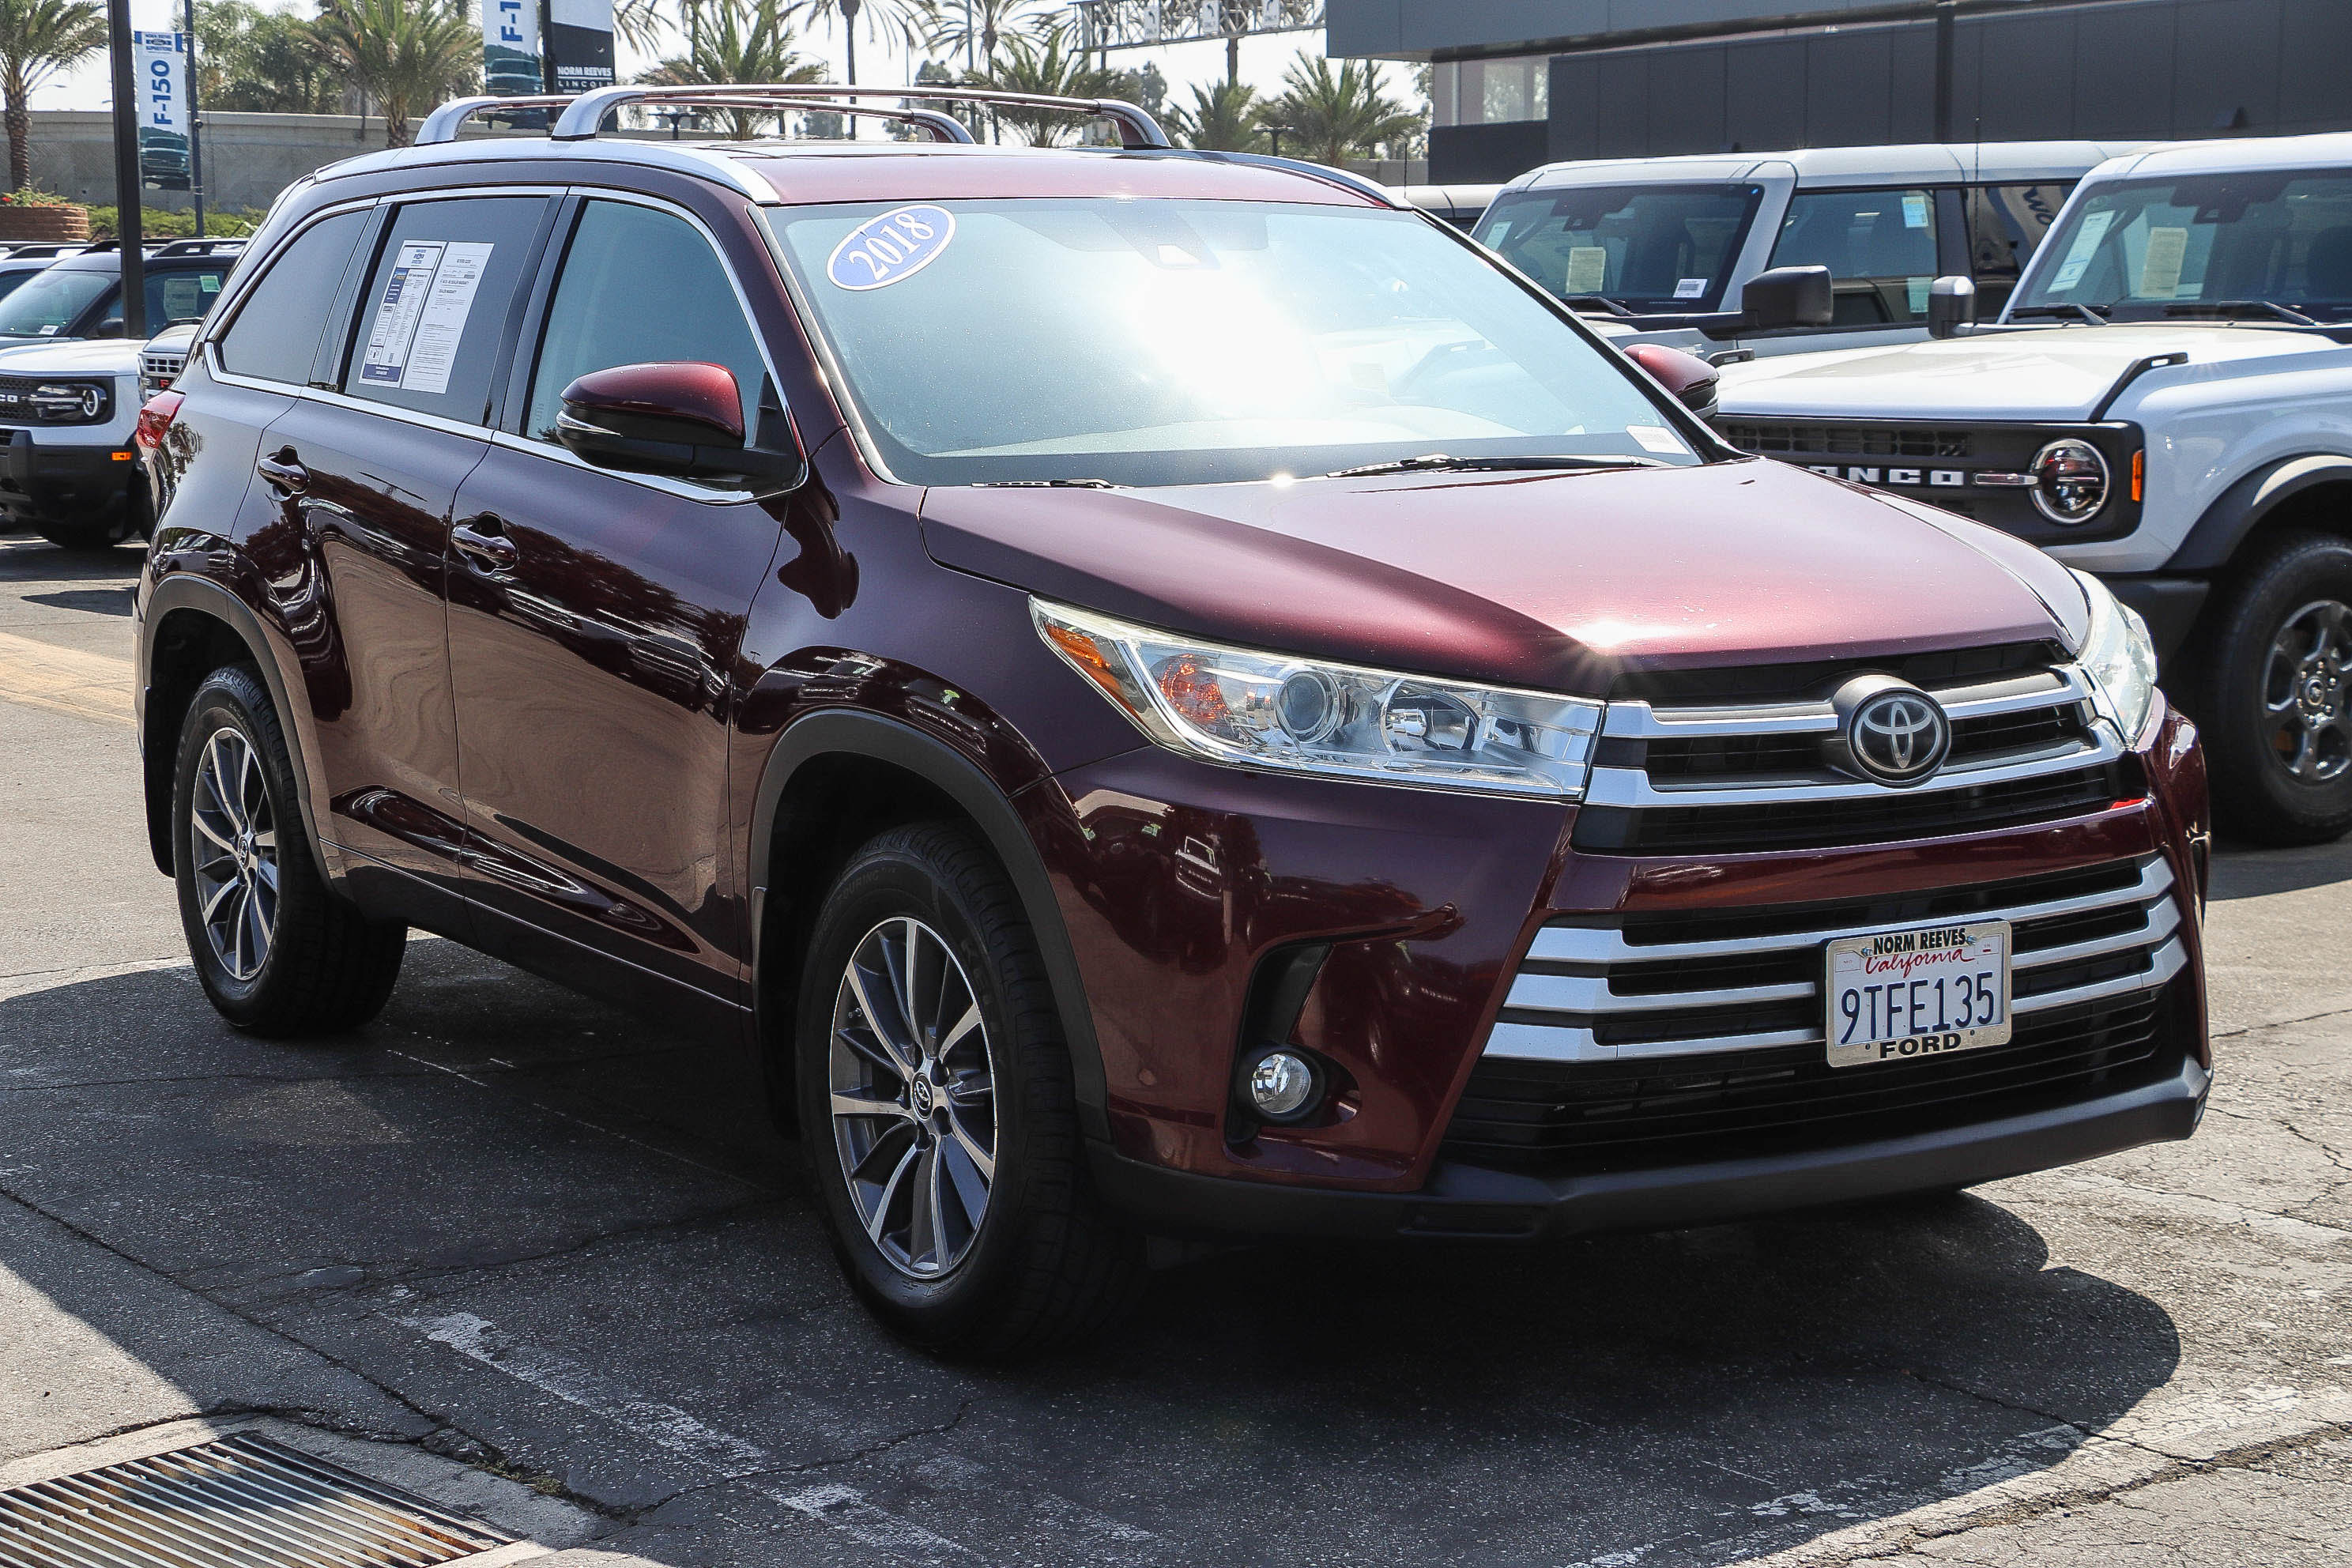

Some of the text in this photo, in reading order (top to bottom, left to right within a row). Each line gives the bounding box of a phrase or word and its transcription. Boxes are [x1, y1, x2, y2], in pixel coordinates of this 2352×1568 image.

[499, 1, 523, 42] F-1
[556, 66, 613, 77] NORM REEVES
[150, 59, 172, 125] F-150
[848, 213, 935, 281] 2018
[1873, 928, 1966, 955] NORM REEVES
[1864, 948, 1976, 978] California
[1840, 971, 1995, 1044] 9TFE135
[1879, 1032, 1962, 1058] FORD
